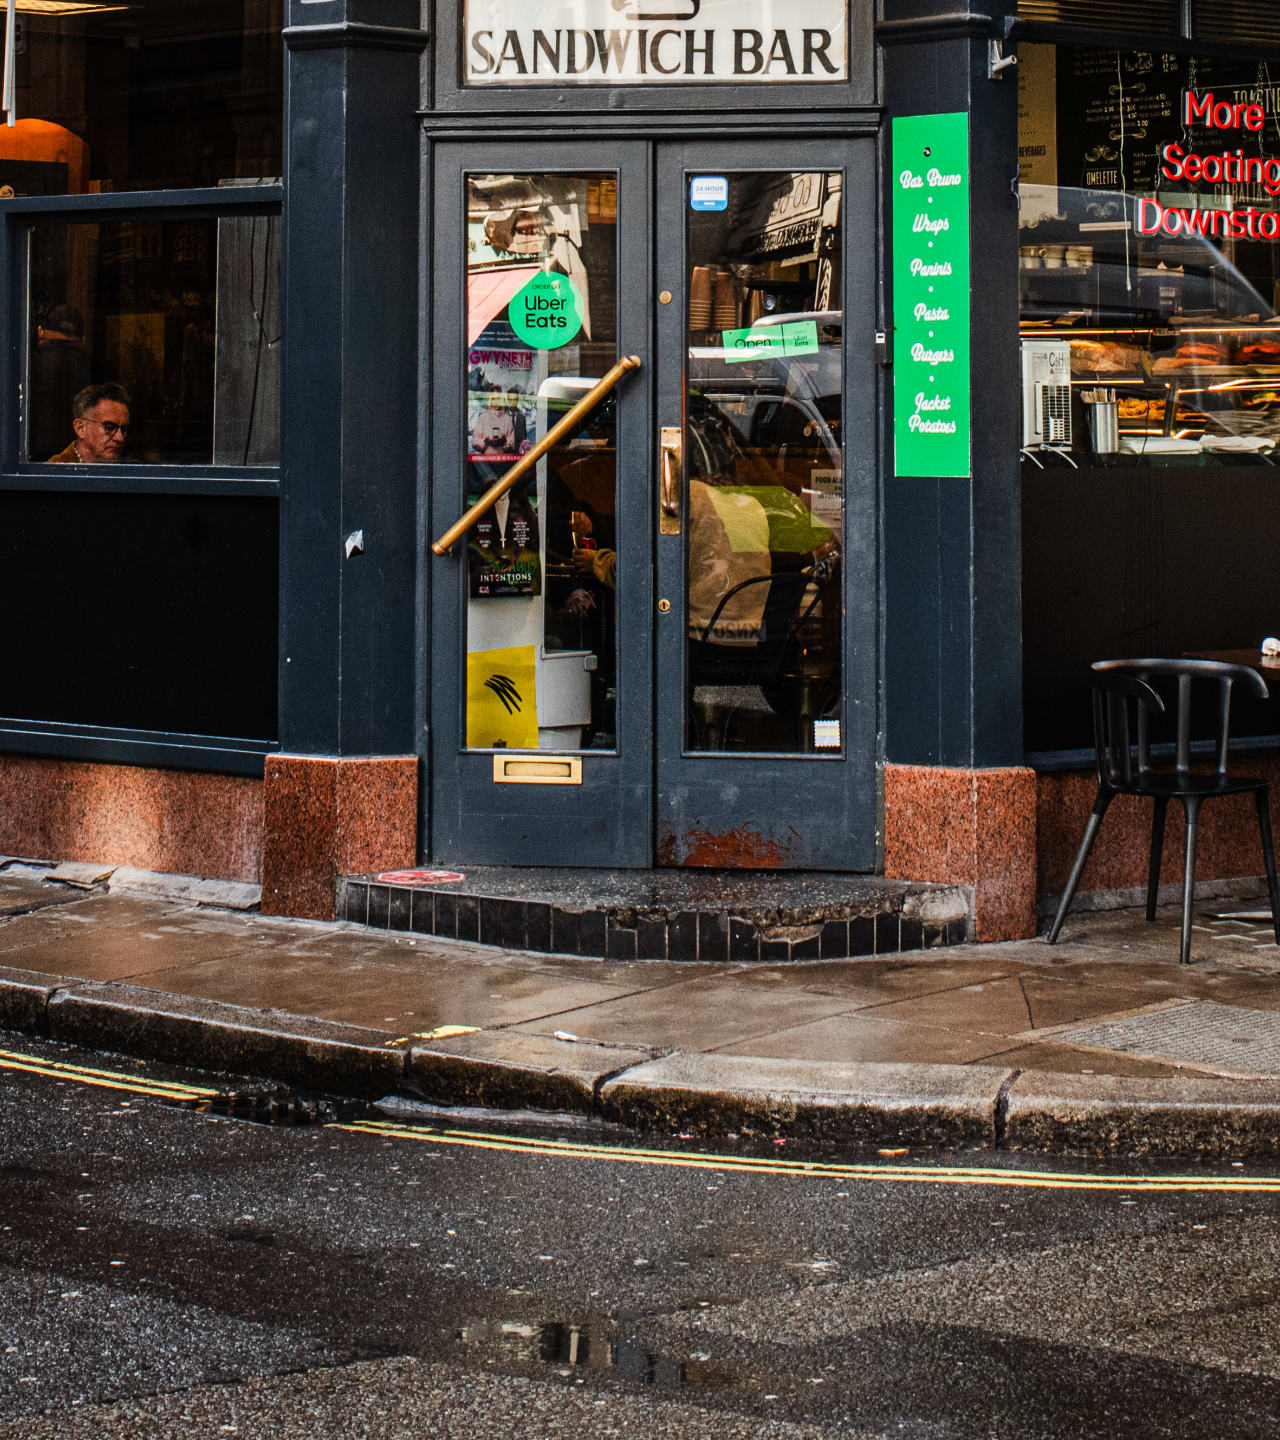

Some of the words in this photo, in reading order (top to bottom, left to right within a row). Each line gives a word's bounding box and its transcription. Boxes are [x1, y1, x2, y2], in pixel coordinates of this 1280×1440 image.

[471, 29, 715, 75] SANDWICH
[732, 28, 840, 76] BAR
[1184, 91, 1265, 131] More
[900, 170, 924, 189] Bar
[927, 168, 961, 187] Bruno
[1086, 170, 1118, 186] OMELETTE
[912, 214, 949, 236] Wraps
[910, 258, 952, 277] Paninis
[525, 295, 567, 311] Uber
[914, 302, 950, 321] Pasta
[525, 313, 567, 328] Eats
[735, 338, 771, 352] Open
[911, 343, 955, 366] Burgers
[470, 351, 533, 365] GWYNETH
[915, 392, 951, 414] Jacket
[908, 414, 956, 433] Potatoes
[480, 572, 532, 583] INTENTIONS
